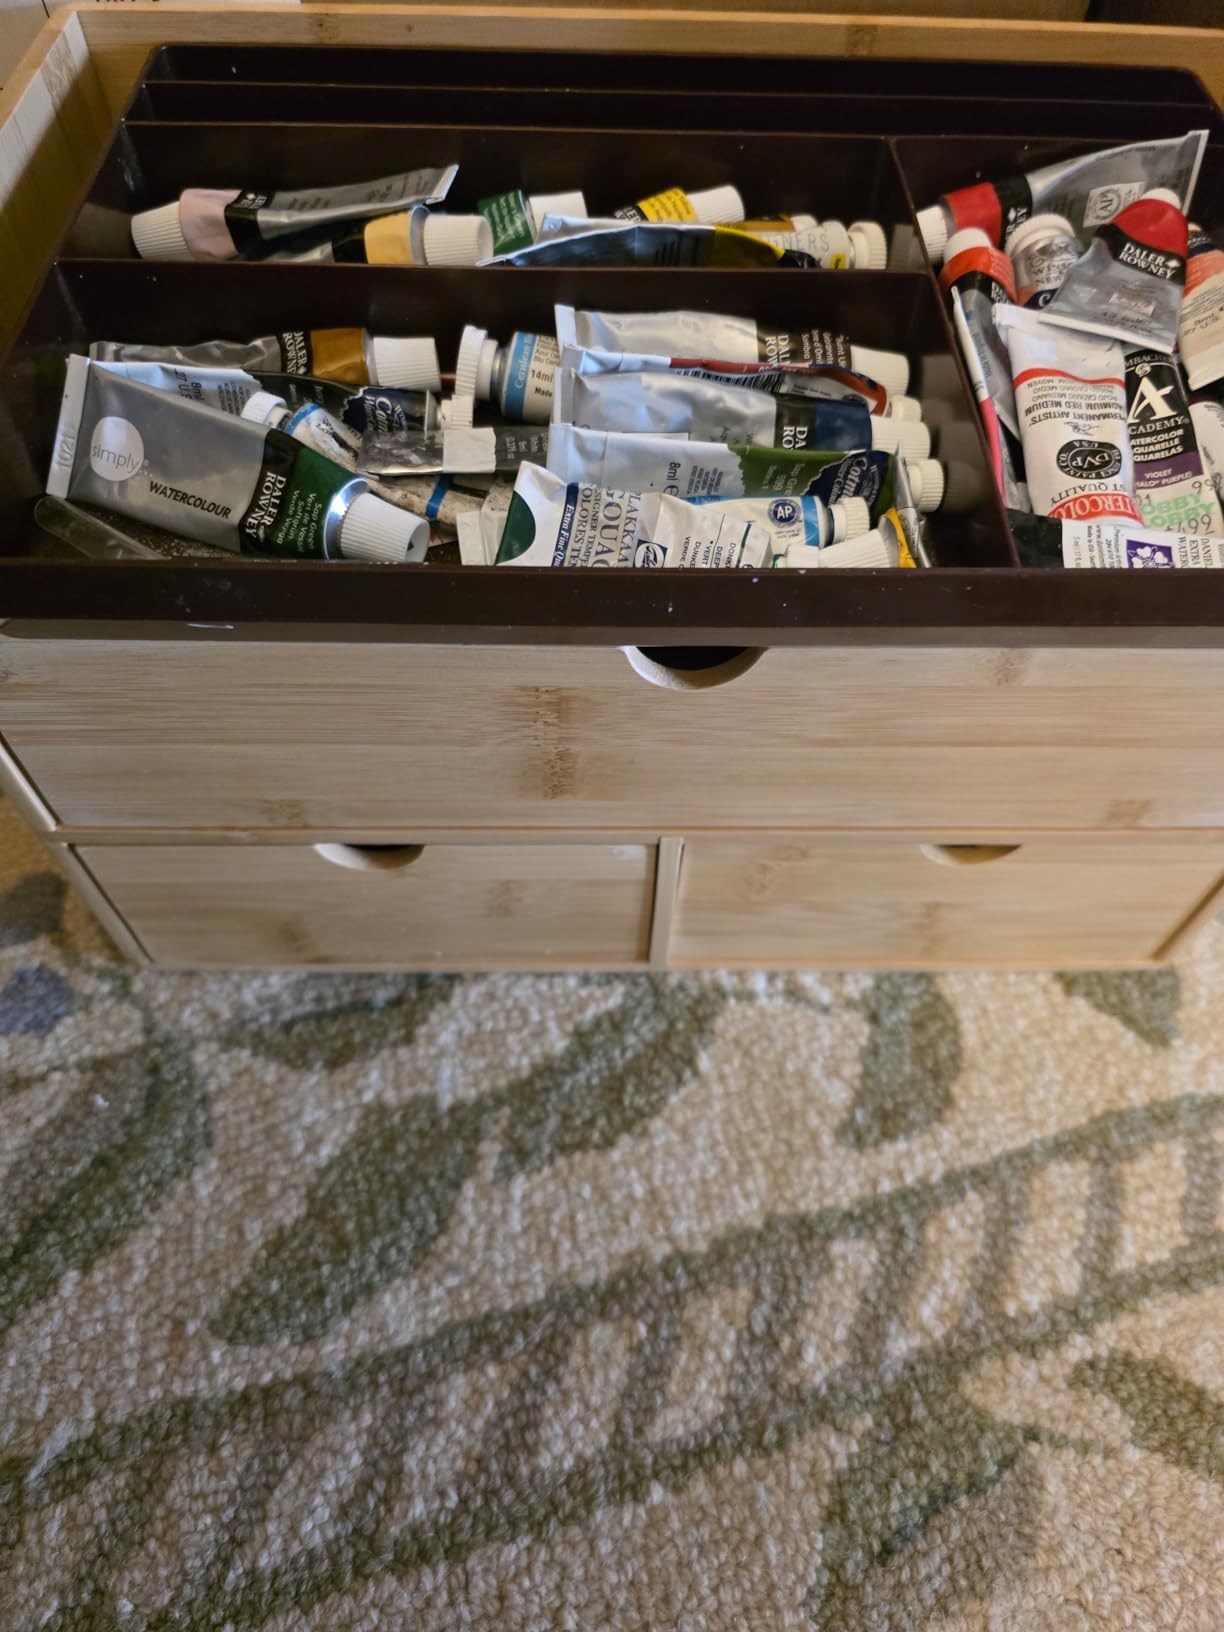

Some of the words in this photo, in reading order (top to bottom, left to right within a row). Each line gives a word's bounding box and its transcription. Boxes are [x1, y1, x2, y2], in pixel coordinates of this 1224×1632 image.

[1123, 242, 1166, 266] DALER
[1119, 252, 1176, 280] ROWNEY
[534, 387, 553, 398] Made
[1024, 400, 1063, 417] MEDIUM
[1065, 400, 1083, 410] RED
[1072, 440, 1100, 449] USA
[1133, 445, 1184, 462] QUARELAS
[91, 444, 142, 474] simply
[1071, 452, 1112, 469] DVP
[665, 462, 682, 482] 8ml
[1144, 468, 1172, 479] VIOLET
[148, 480, 232, 520] WATERCOLOUR
[262, 474, 287, 527] DALER
[287, 490, 301, 517] Verde
[305, 492, 317, 510] Vert
[1050, 482, 1109, 503] QUALITY
[245, 471, 277, 539] ROWNEY
[311, 503, 323, 521] Sap
[573, 480, 595, 547] OLORES
[776, 505, 794, 521] AP
[302, 512, 312, 525] de
[560, 504, 576, 532] Extra
[616, 489, 642, 564] LAKKAA
[276, 517, 292, 545] Vejiga
[556, 531, 571, 552] Fine
[679, 536, 691, 562] VERDE
[701, 545, 714, 566] VERT
[713, 545, 723, 568] DEEP
[1188, 539, 1201, 566] EXTRA
[1200, 537, 1214, 568] DANIEL
